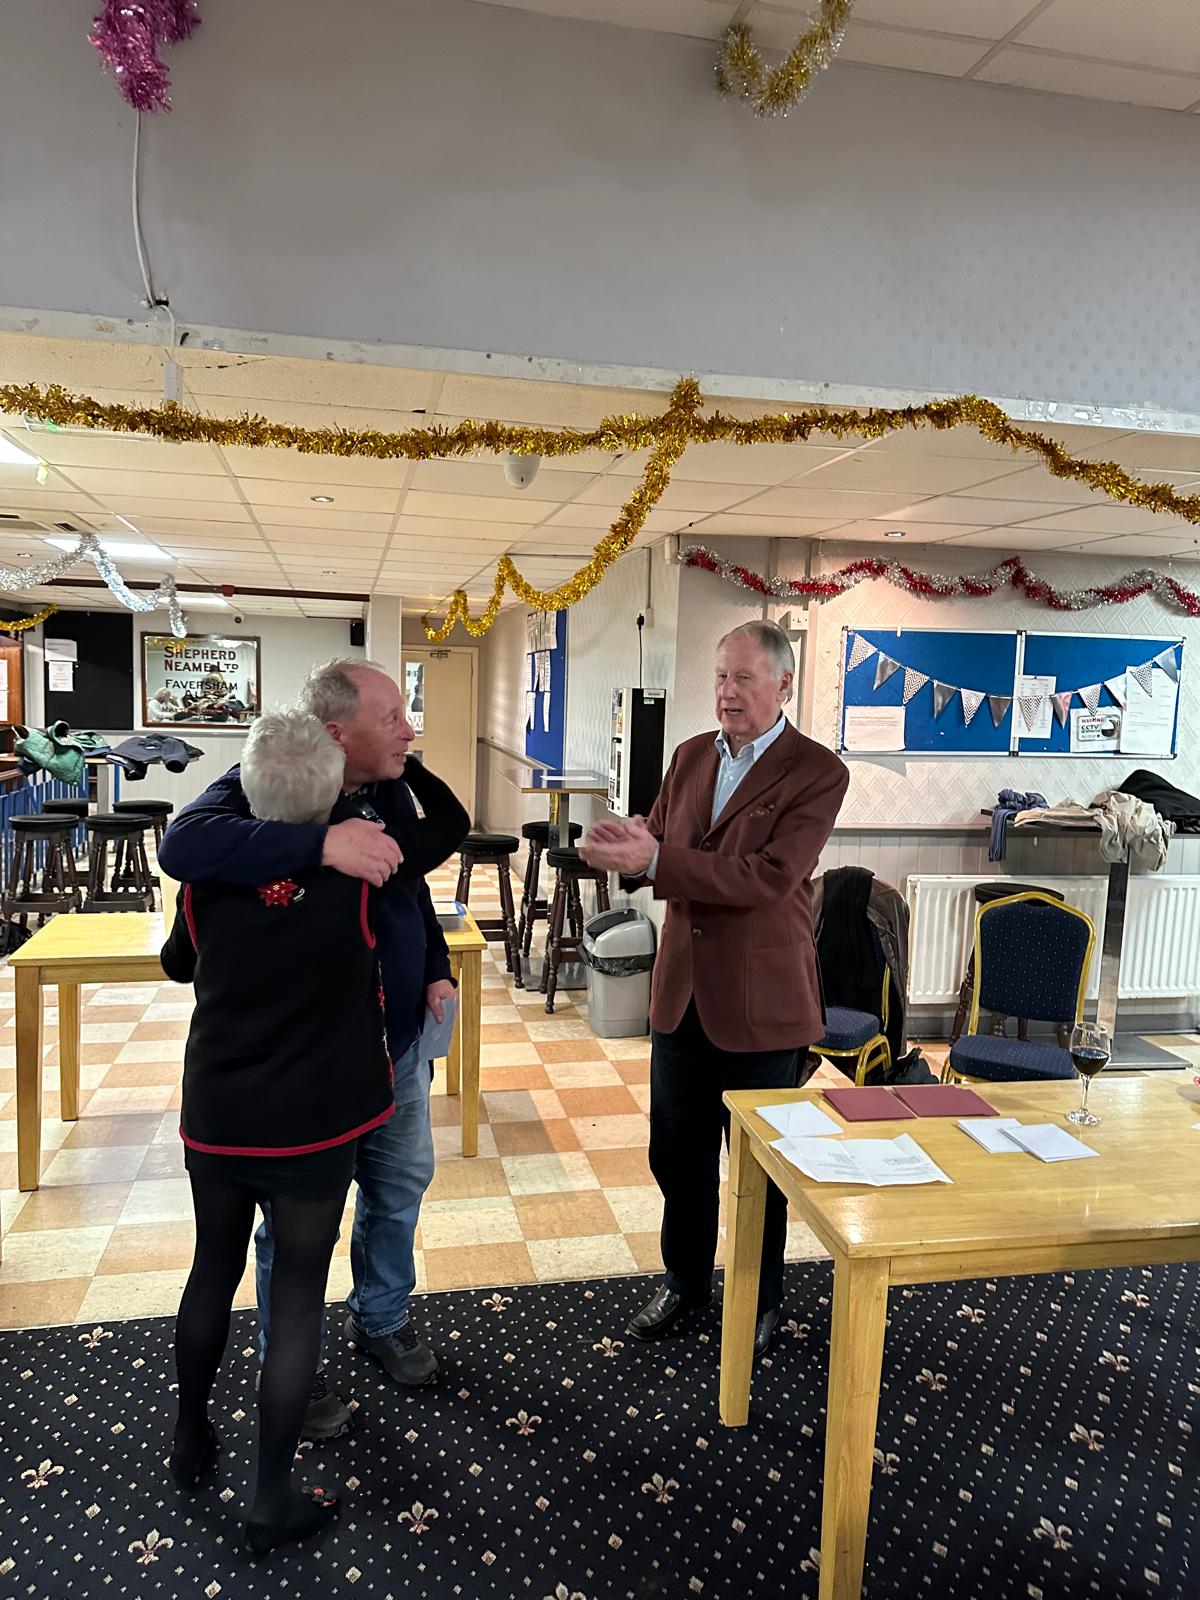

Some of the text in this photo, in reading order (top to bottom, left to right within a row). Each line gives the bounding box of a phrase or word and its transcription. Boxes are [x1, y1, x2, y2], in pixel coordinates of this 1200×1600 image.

[164, 646, 236, 660] SHEPHERD
[164, 660, 211, 672] NEAME
[165, 679, 238, 691] FAVERSHAM
